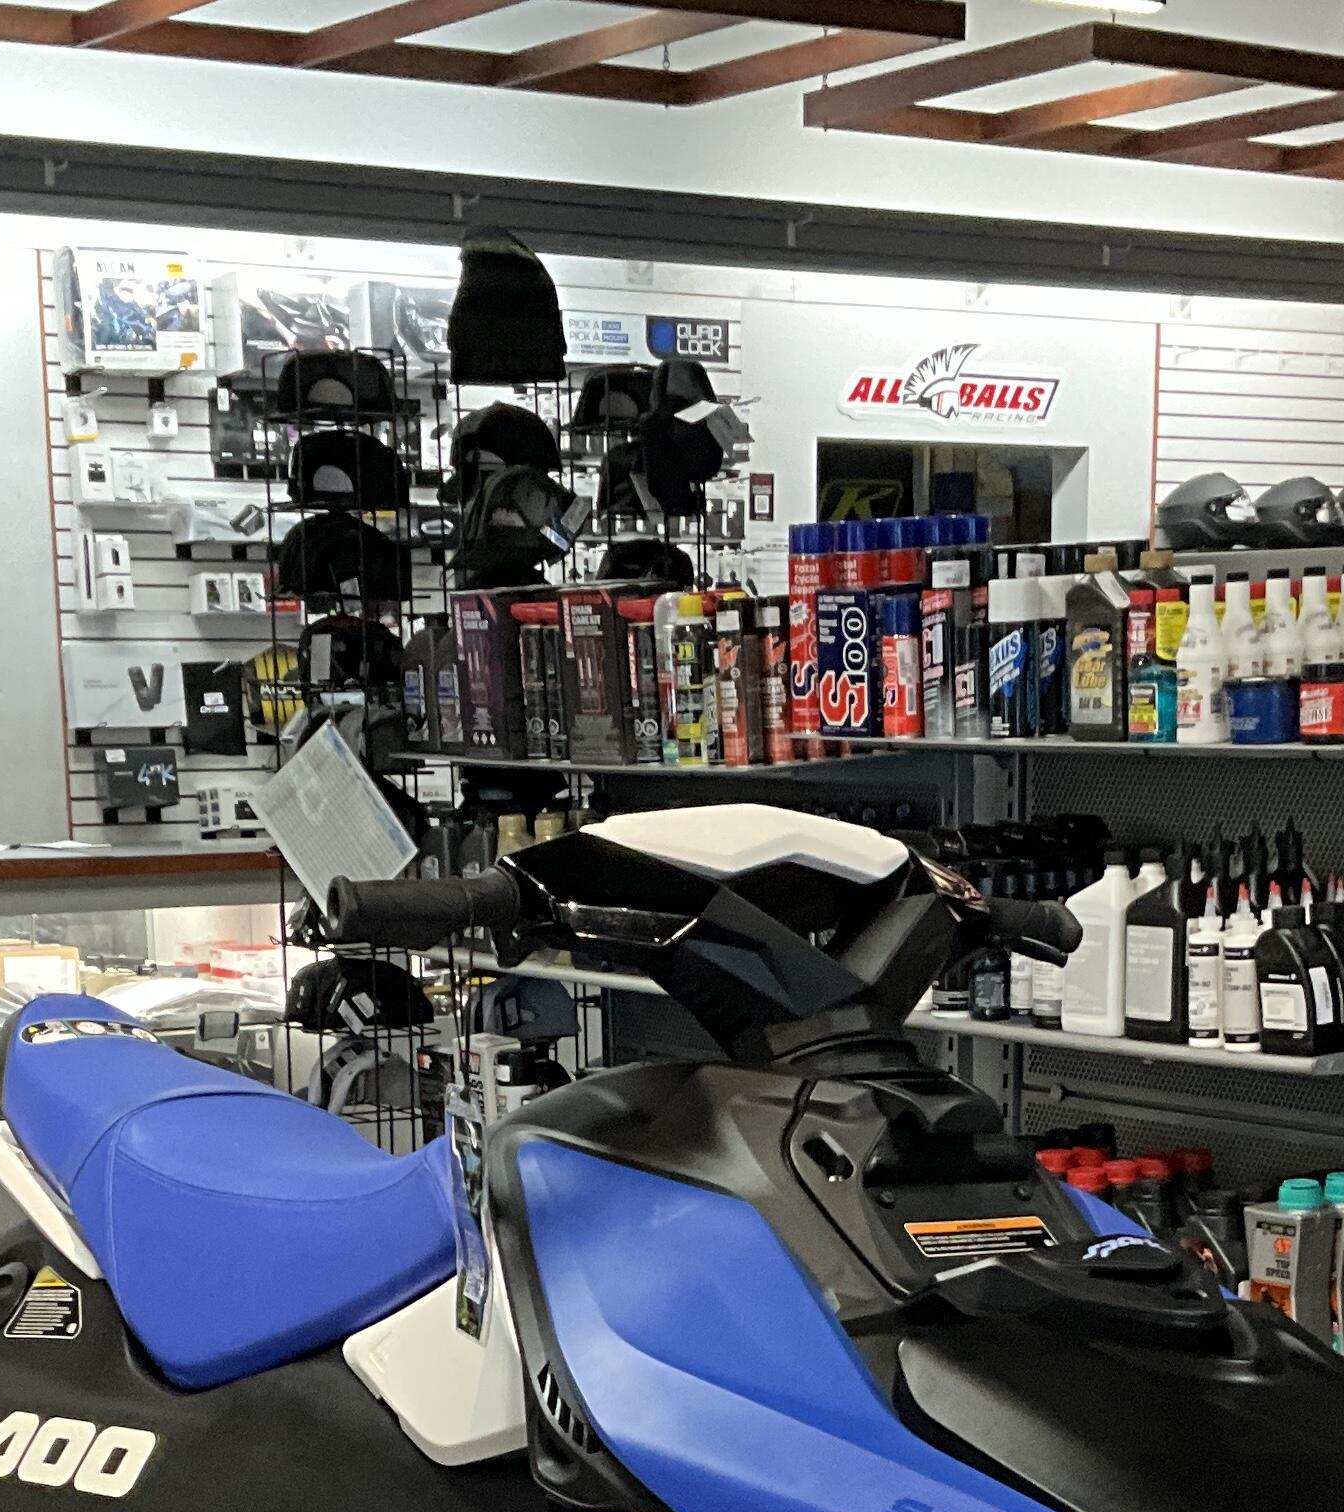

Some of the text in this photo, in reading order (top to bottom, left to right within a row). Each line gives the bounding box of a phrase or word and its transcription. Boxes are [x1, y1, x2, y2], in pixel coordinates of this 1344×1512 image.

[676, 323, 722, 340] QUAD
[676, 339, 722, 356] LOCK
[848, 376, 1045, 412] ALL BALLS
[972, 411, 1038, 423] RACING
[794, 563, 820, 574] Total
